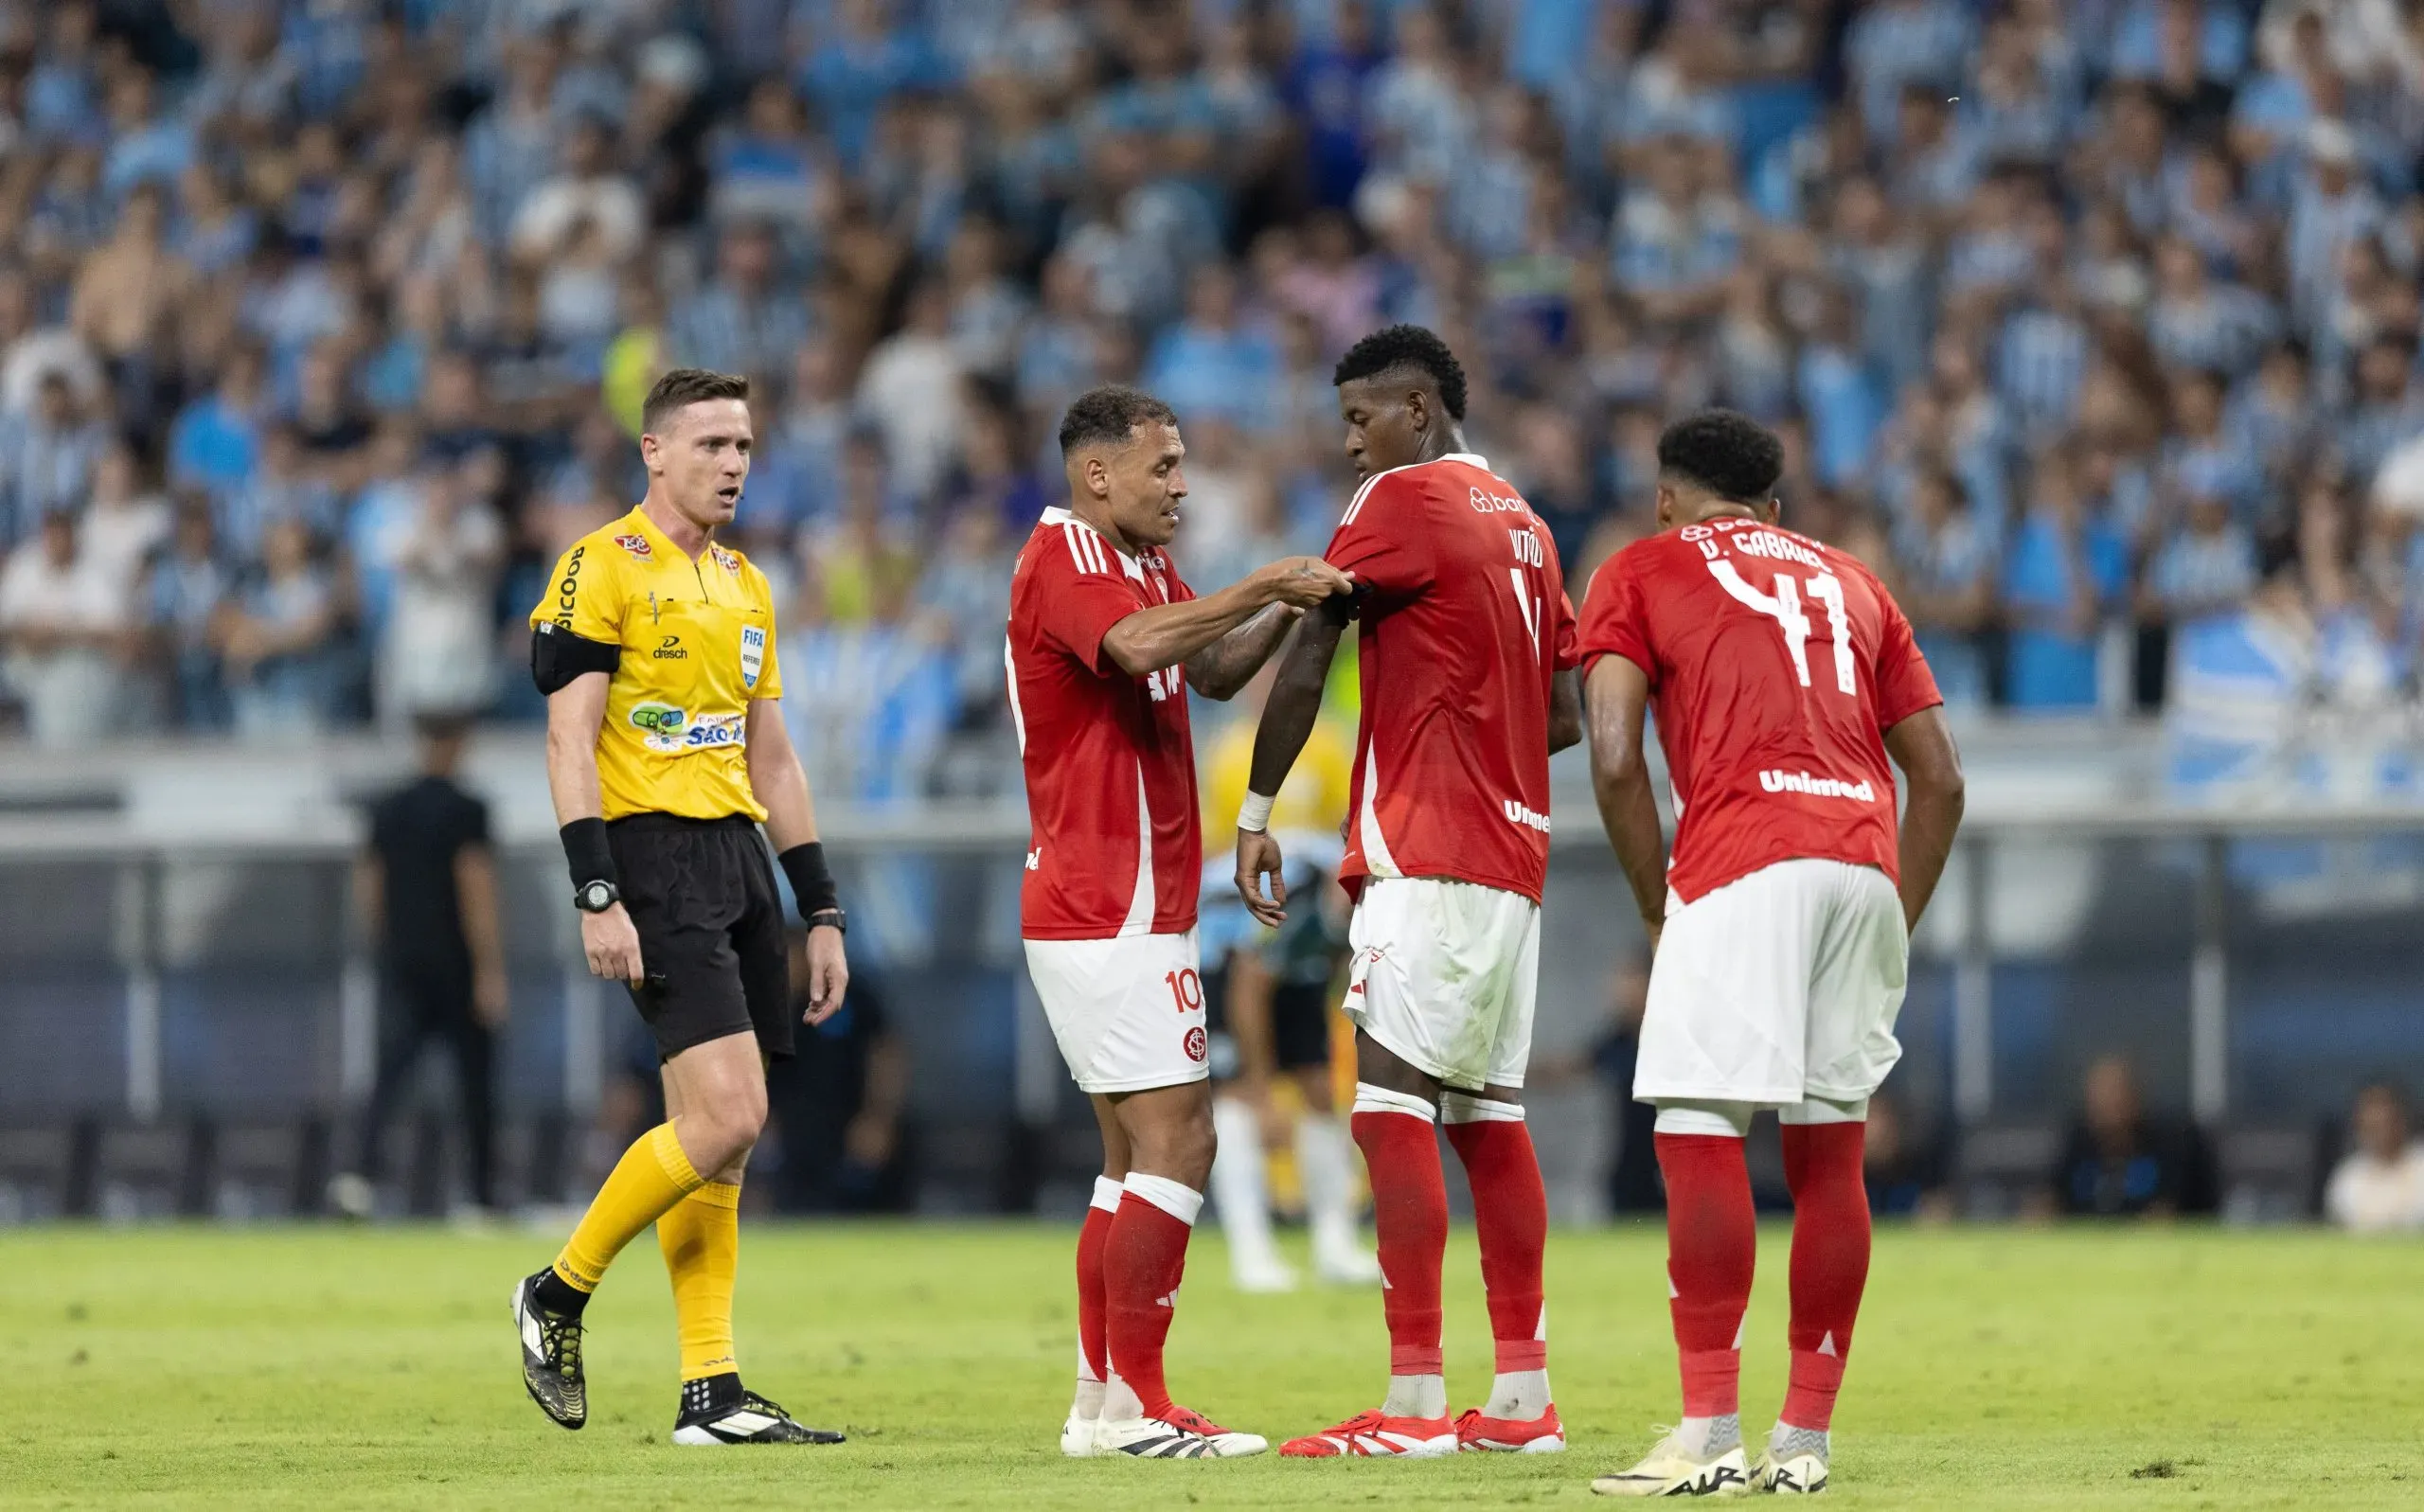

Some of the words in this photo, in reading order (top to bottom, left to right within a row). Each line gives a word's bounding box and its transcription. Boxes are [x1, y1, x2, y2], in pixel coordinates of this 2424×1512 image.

[744, 630, 763, 648] FIFA
[1706, 560, 1856, 696] 41
[653, 648, 687, 660] dresch
[742, 653, 760, 666] REFEREE
[1759, 770, 1876, 803] Unimed
[1165, 968, 1201, 1013] 10
